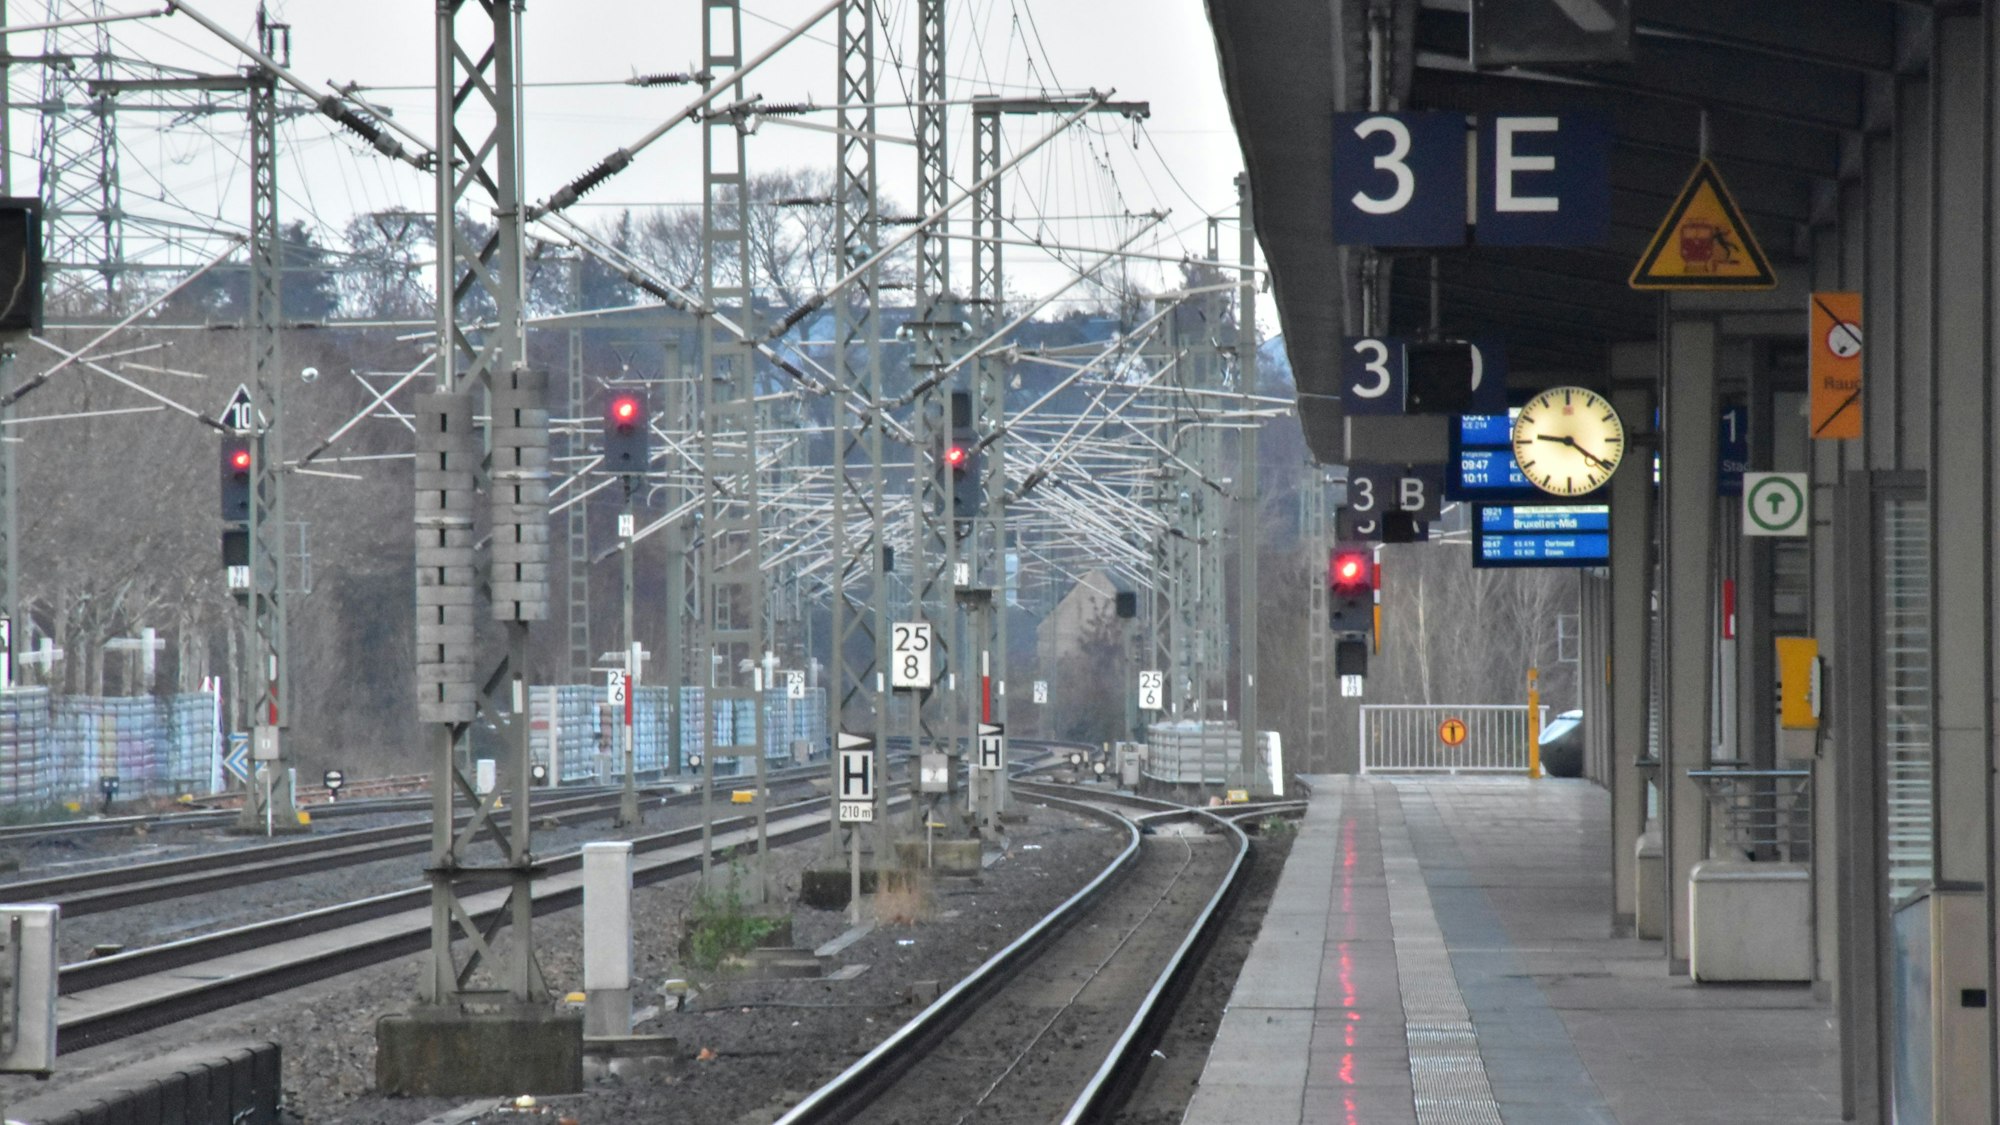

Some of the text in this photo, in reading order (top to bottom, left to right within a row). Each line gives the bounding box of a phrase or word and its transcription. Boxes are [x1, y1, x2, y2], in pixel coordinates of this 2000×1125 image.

[1351, 117, 1414, 214] 3
[1496, 117, 1559, 212] E
[1352, 339, 1391, 398] 3
[232, 402, 251, 428] 10
[1723, 410, 1736, 443] 1
[1462, 460, 1488, 470] 09:47
[1463, 473, 1488, 483] 10:11
[1353, 477, 1374, 511] 3
[1400, 478, 1425, 511] B
[1513, 519, 1577, 529] Bruxelles-Midi
[895, 626, 929, 652] 25
[789, 672, 804, 684] 25
[903, 655, 920, 680] 8
[1141, 672, 1162, 688] 25
[614, 687, 624, 702] 6
[793, 686, 800, 696] 4
[1146, 689, 1156, 705] 6
[982, 739, 1000, 767] H
[843, 754, 869, 795] H
[841, 804, 872, 819] 210 m
